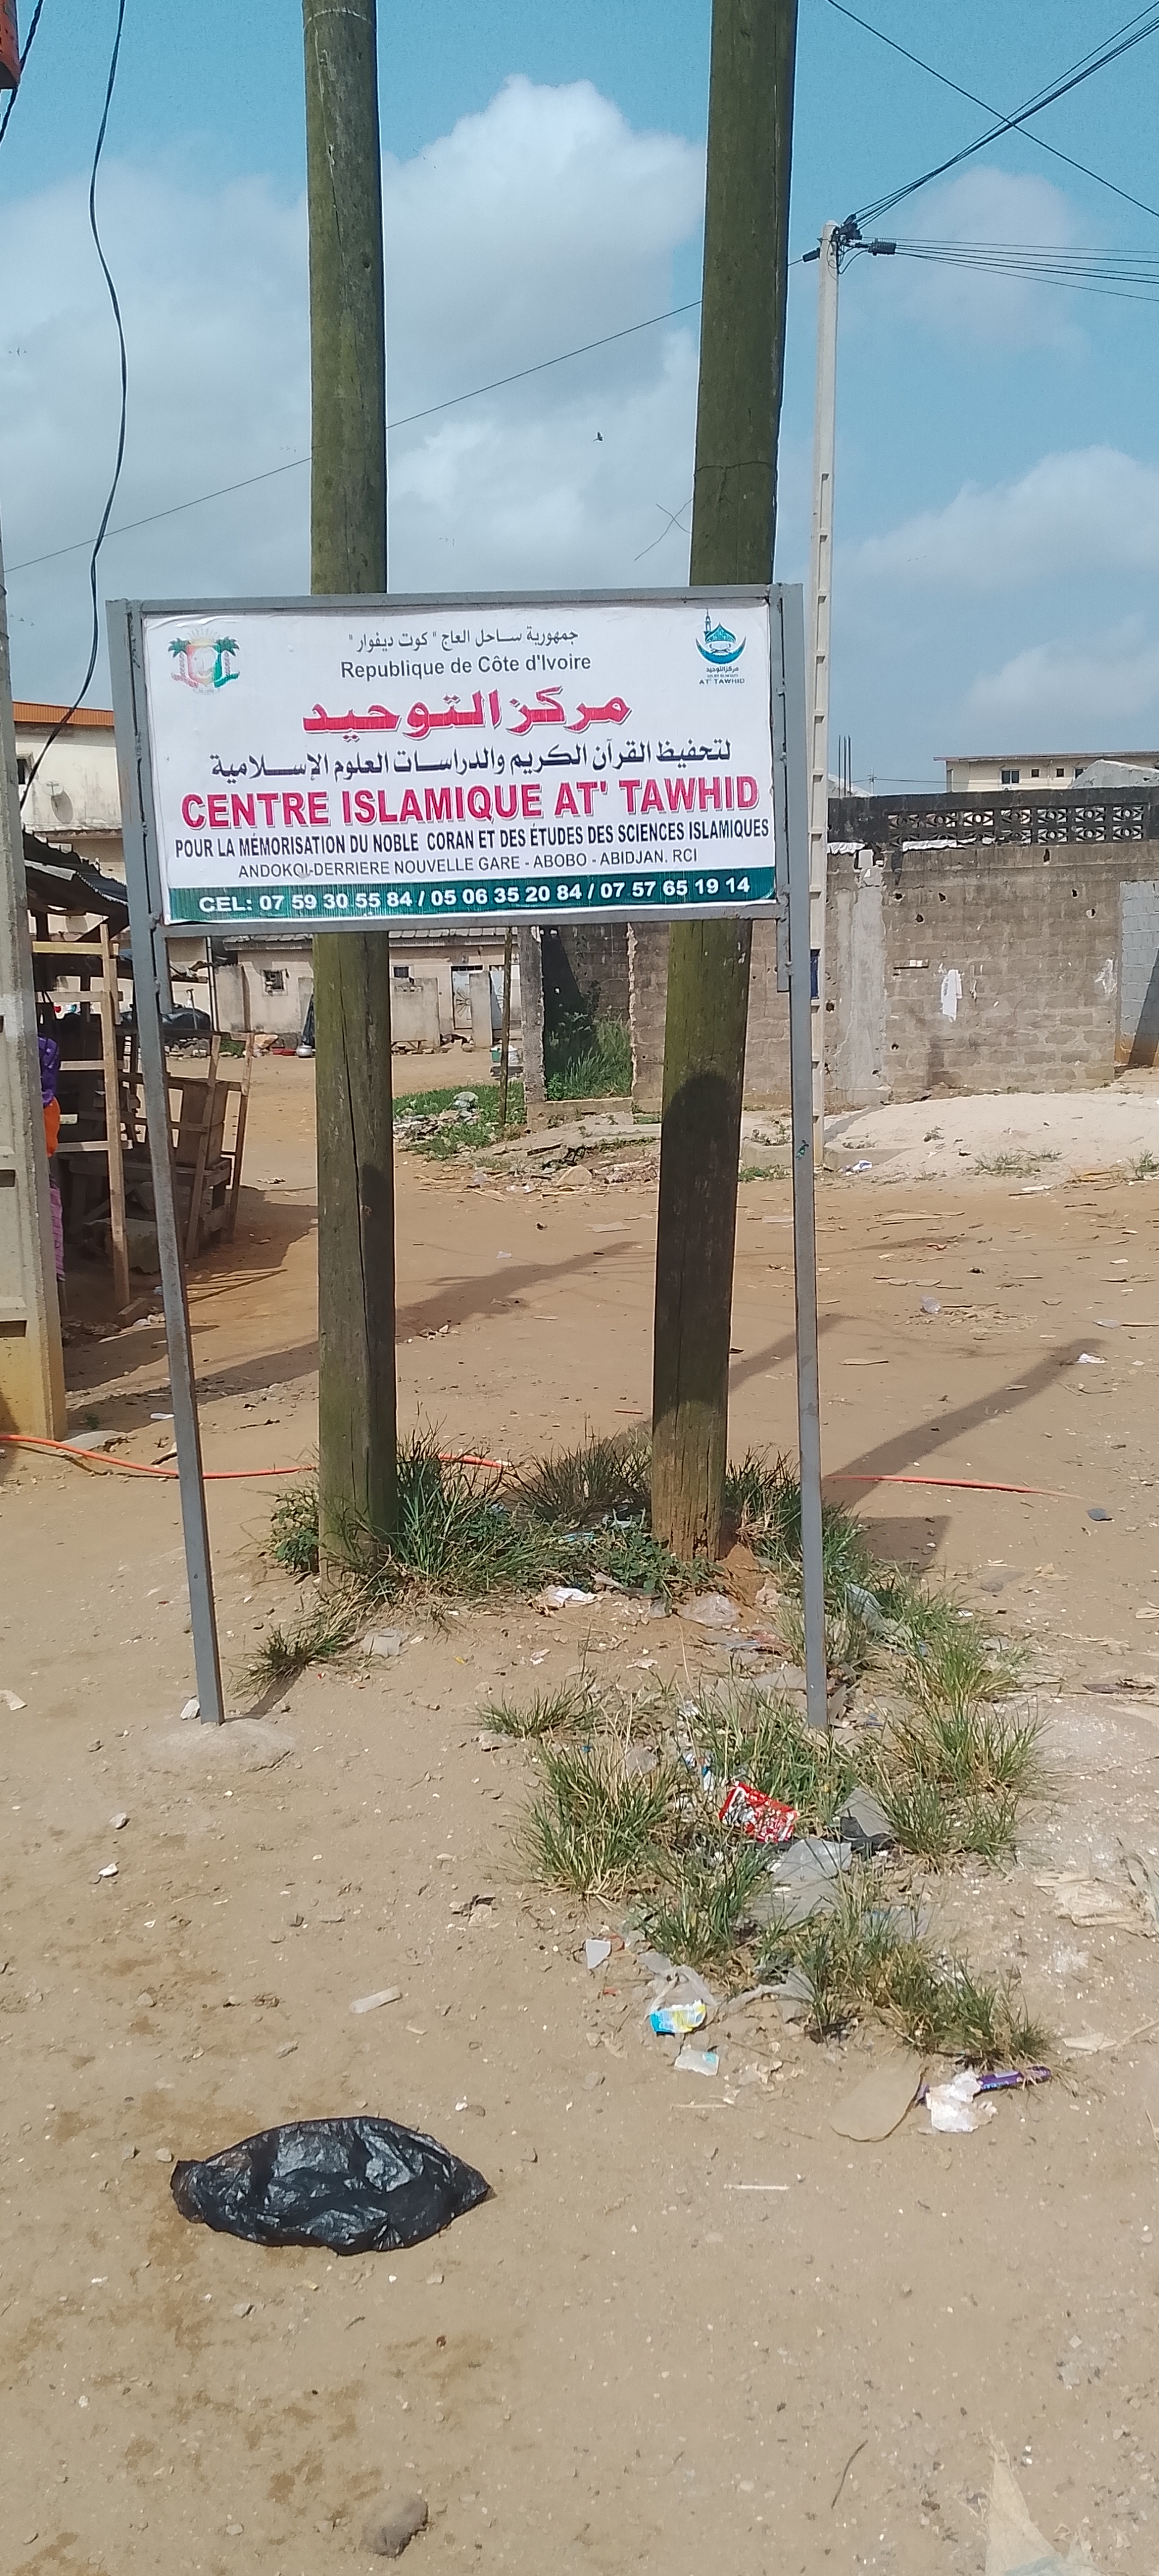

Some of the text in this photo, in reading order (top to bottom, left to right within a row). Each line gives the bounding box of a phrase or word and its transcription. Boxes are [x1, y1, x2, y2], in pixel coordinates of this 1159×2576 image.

[441, 629, 471, 651] العاج
[475, 628, 523, 647] ساحل
[527, 625, 579, 646] جمهورية
[341, 653, 591, 682] Republique de Côte d'Ivoire
[302, 685, 630, 741] مركز التوحيد
[209, 738, 731, 784] لتحفيظ القرآن الكريم والدراسات العلوم الإسلامية
[181, 775, 761, 830] CENTRE ISLAMIQUE AT' TAWHID
[175, 817, 770, 858] POUR LA MÉMORISATION DU NOBLE CORAN ET DES ÉTUDES DES SCIENCES ISLAMIQUES
[238, 861, 390, 879] ANDOKOI-DERRIERE
[394, 857, 474, 874] NOUVELLE
[478, 855, 520, 871] GARE
[533, 852, 588, 868] ABOBO
[599, 849, 668, 866] ABIDJAN.
[672, 847, 697, 863] RCI
[198, 895, 252, 913] CEL:
[259, 894, 284, 911] 07
[292, 893, 316, 910] 59
[323, 894, 348, 909] 30
[355, 891, 380, 908] 55
[386, 890, 412, 907] 84
[432, 889, 456, 906] 05
[462, 888, 488, 905] 06
[494, 886, 519, 903] 35
[526, 885, 550, 902] 20
[557, 883, 582, 900] 84
[601, 881, 625, 899] 07
[632, 880, 656, 897] 57
[662, 879, 688, 896] 65
[695, 878, 719, 895] 19
[726, 876, 750, 894] 14
